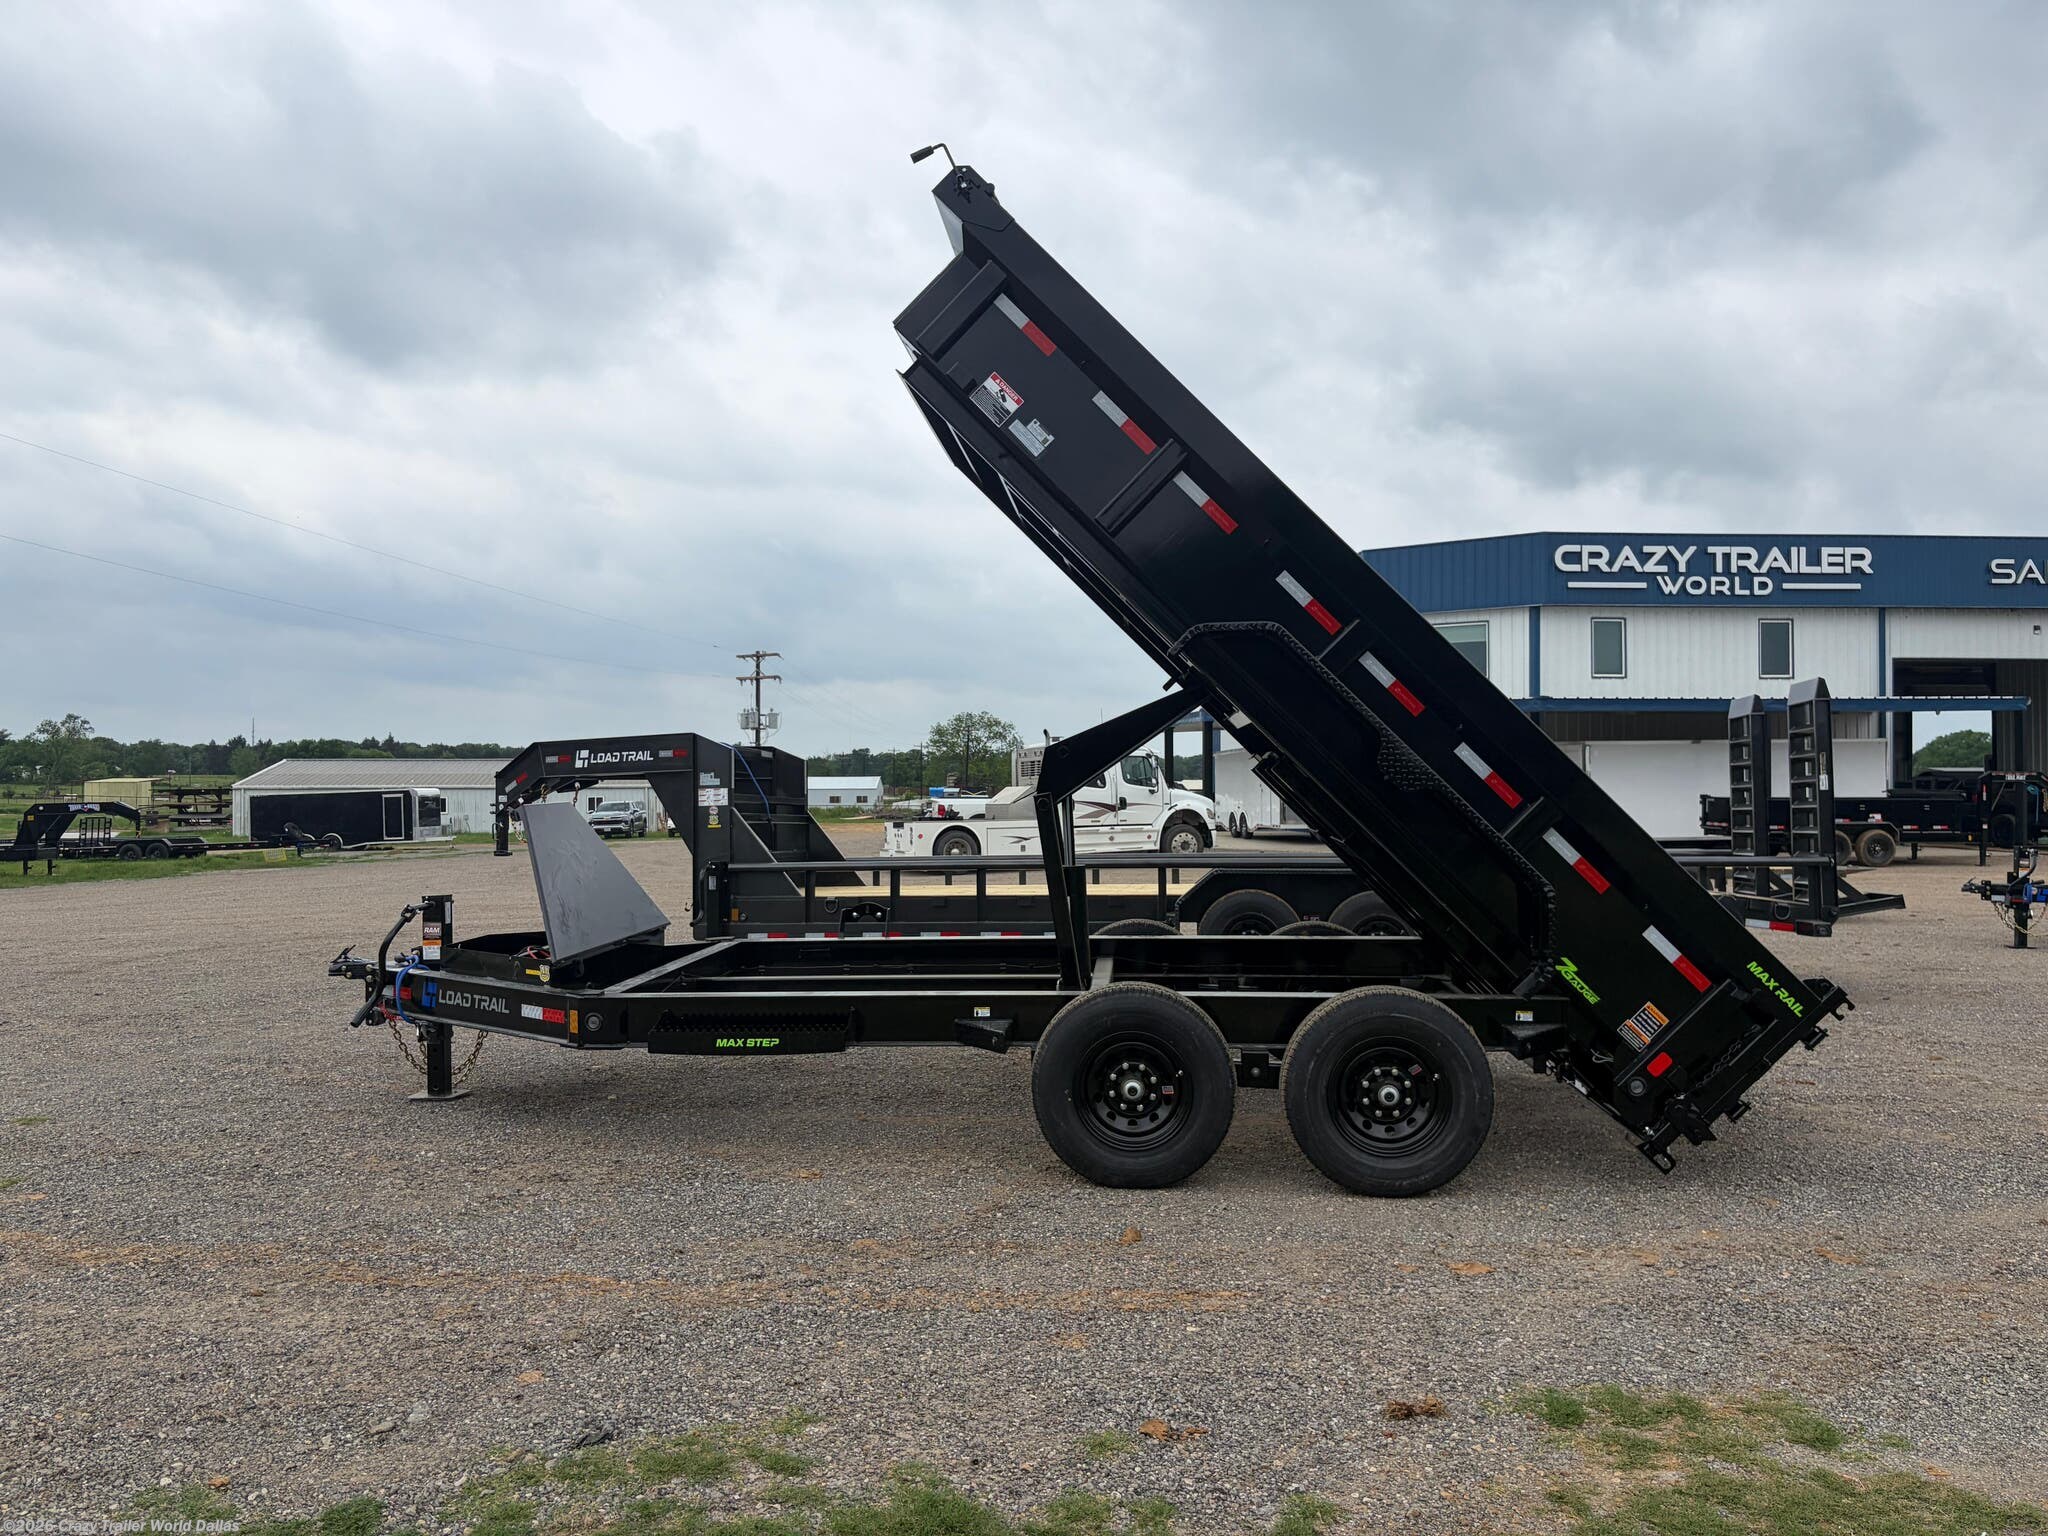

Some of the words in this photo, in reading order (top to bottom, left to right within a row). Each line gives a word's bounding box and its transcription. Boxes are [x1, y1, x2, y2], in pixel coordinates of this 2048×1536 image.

[1554, 544, 1697, 573] CRAZY
[1707, 546, 1874, 574] TRAILER
[1990, 558, 2048, 584] SA
[1656, 575, 1774, 596] WORLD
[590, 752, 620, 764] LOAD
[622, 750, 654, 762] TRAIL
[424, 926, 440, 934] RAM
[1561, 969, 1600, 1004] GAUGE
[1746, 961, 1779, 991] MAX
[1775, 987, 1803, 1017] RAIL
[439, 988, 472, 1007] LOAD
[473, 994, 510, 1014] TRAIL
[716, 1038, 744, 1047] MAX
[746, 1038, 780, 1047] STEP
